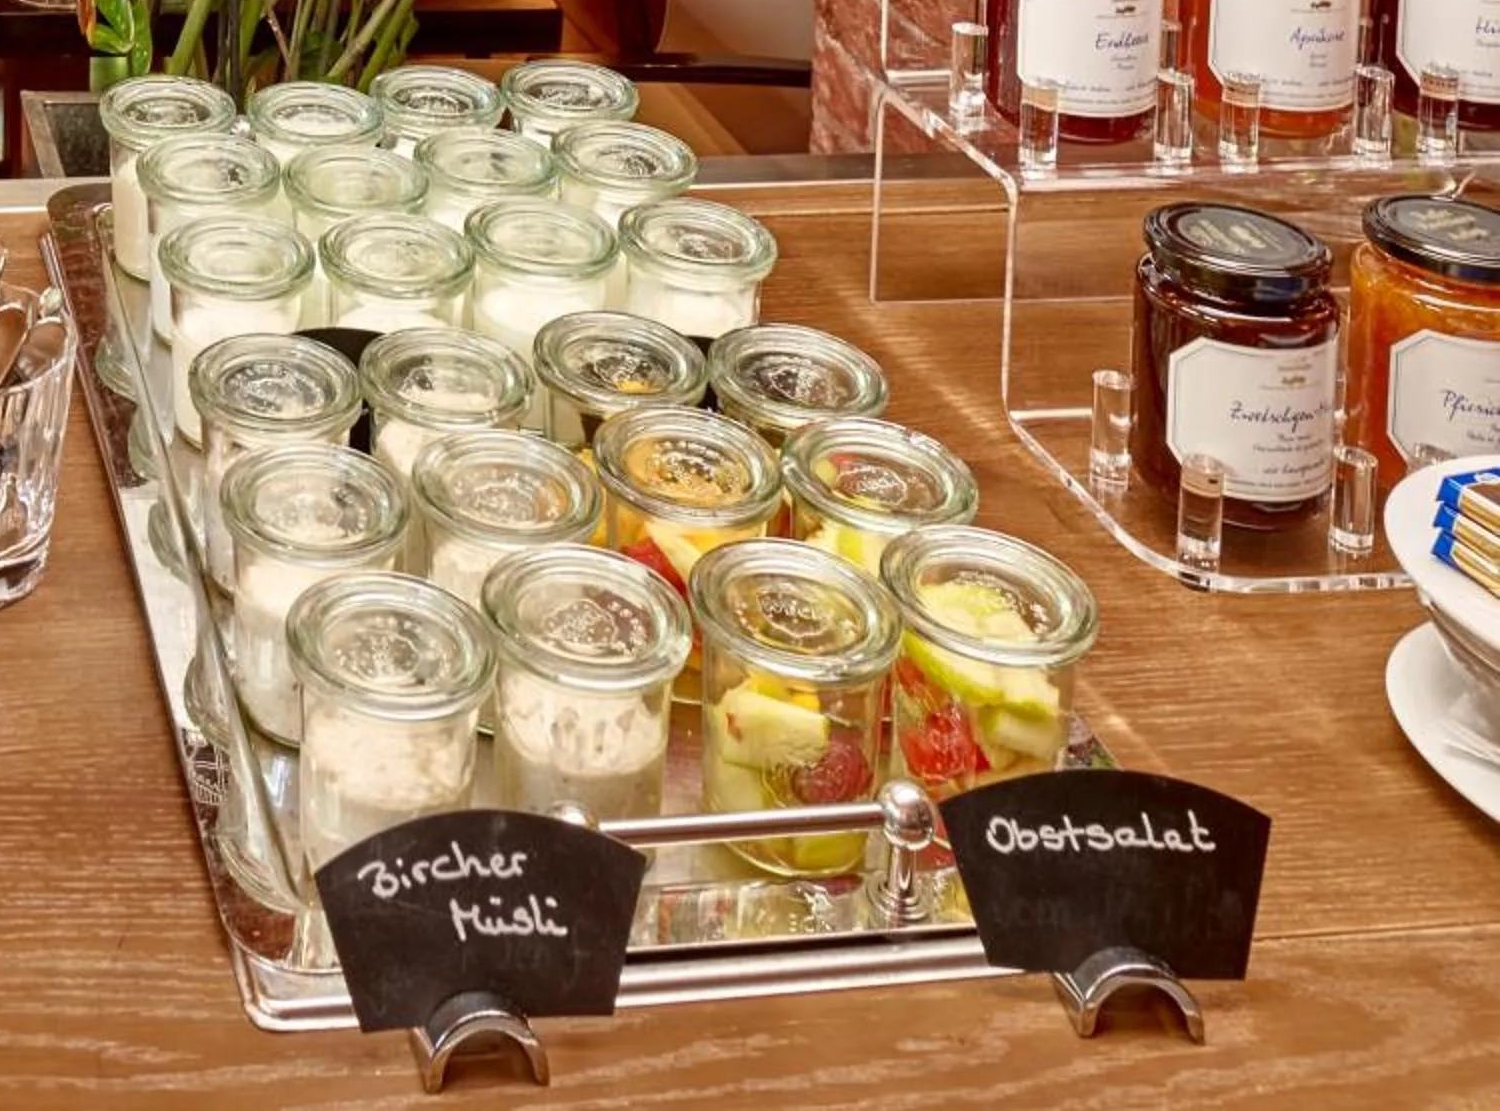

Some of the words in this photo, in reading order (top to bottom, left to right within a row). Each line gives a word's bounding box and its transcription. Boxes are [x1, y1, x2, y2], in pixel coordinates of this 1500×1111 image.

[986, 810, 1216, 854] Obstsalat
[357, 840, 528, 899] Bircher
[449, 894, 568, 942] Müsli
